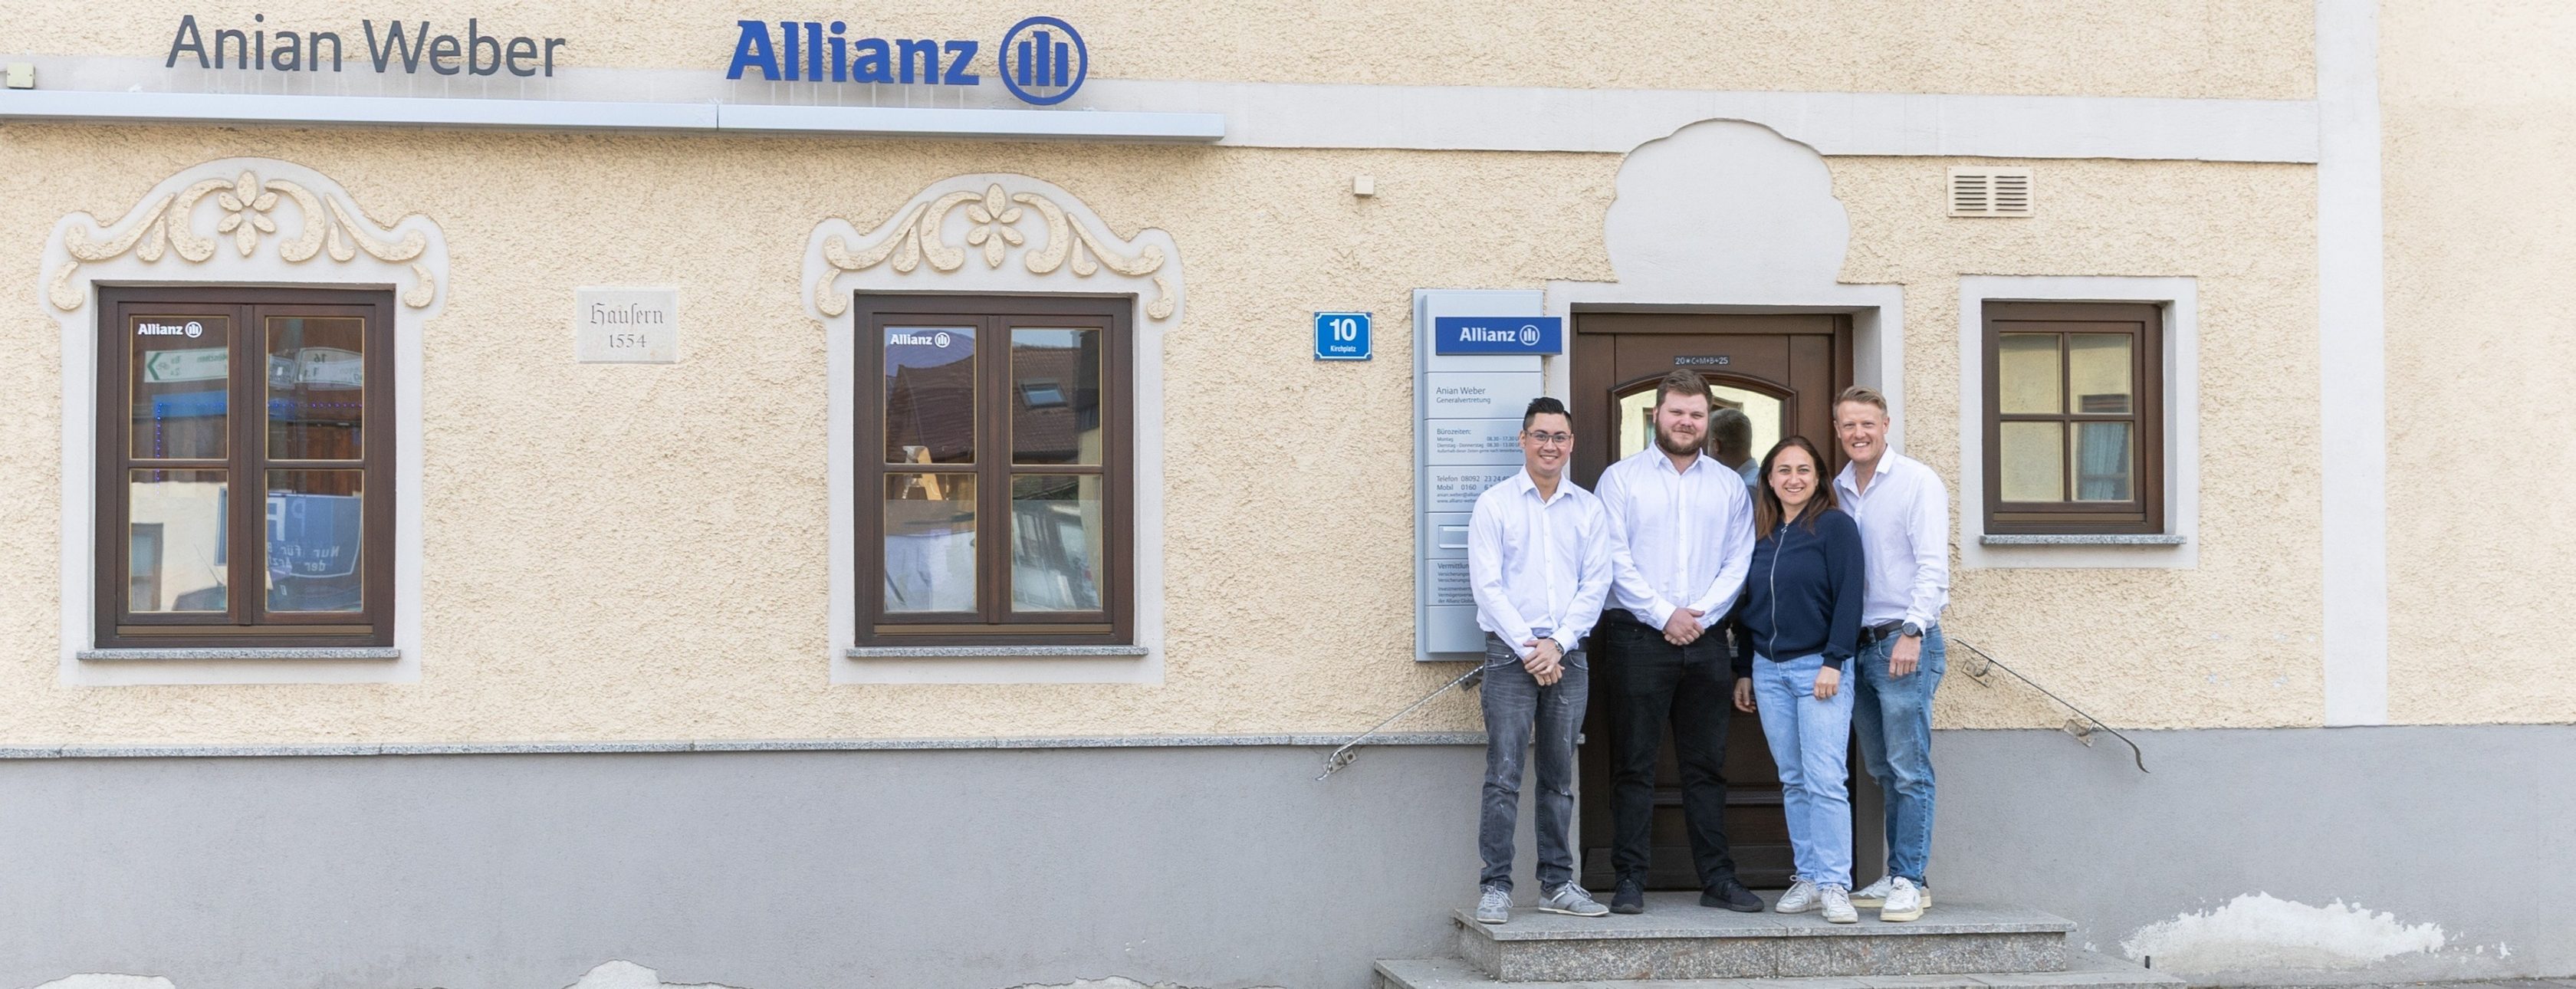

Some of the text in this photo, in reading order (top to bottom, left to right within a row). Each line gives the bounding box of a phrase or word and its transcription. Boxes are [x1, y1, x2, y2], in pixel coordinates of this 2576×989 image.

[166, 14, 566, 78] Anian Weber
[726, 20, 980, 86] Allianz
[138, 323, 183, 335] Allianz
[1329, 318, 1357, 341] 10
[1459, 327, 1516, 342] Allianz
[610, 334, 646, 348] 1554
[889, 334, 932, 346] Allianz
[1330, 345, 1356, 353] Kirchplatz
